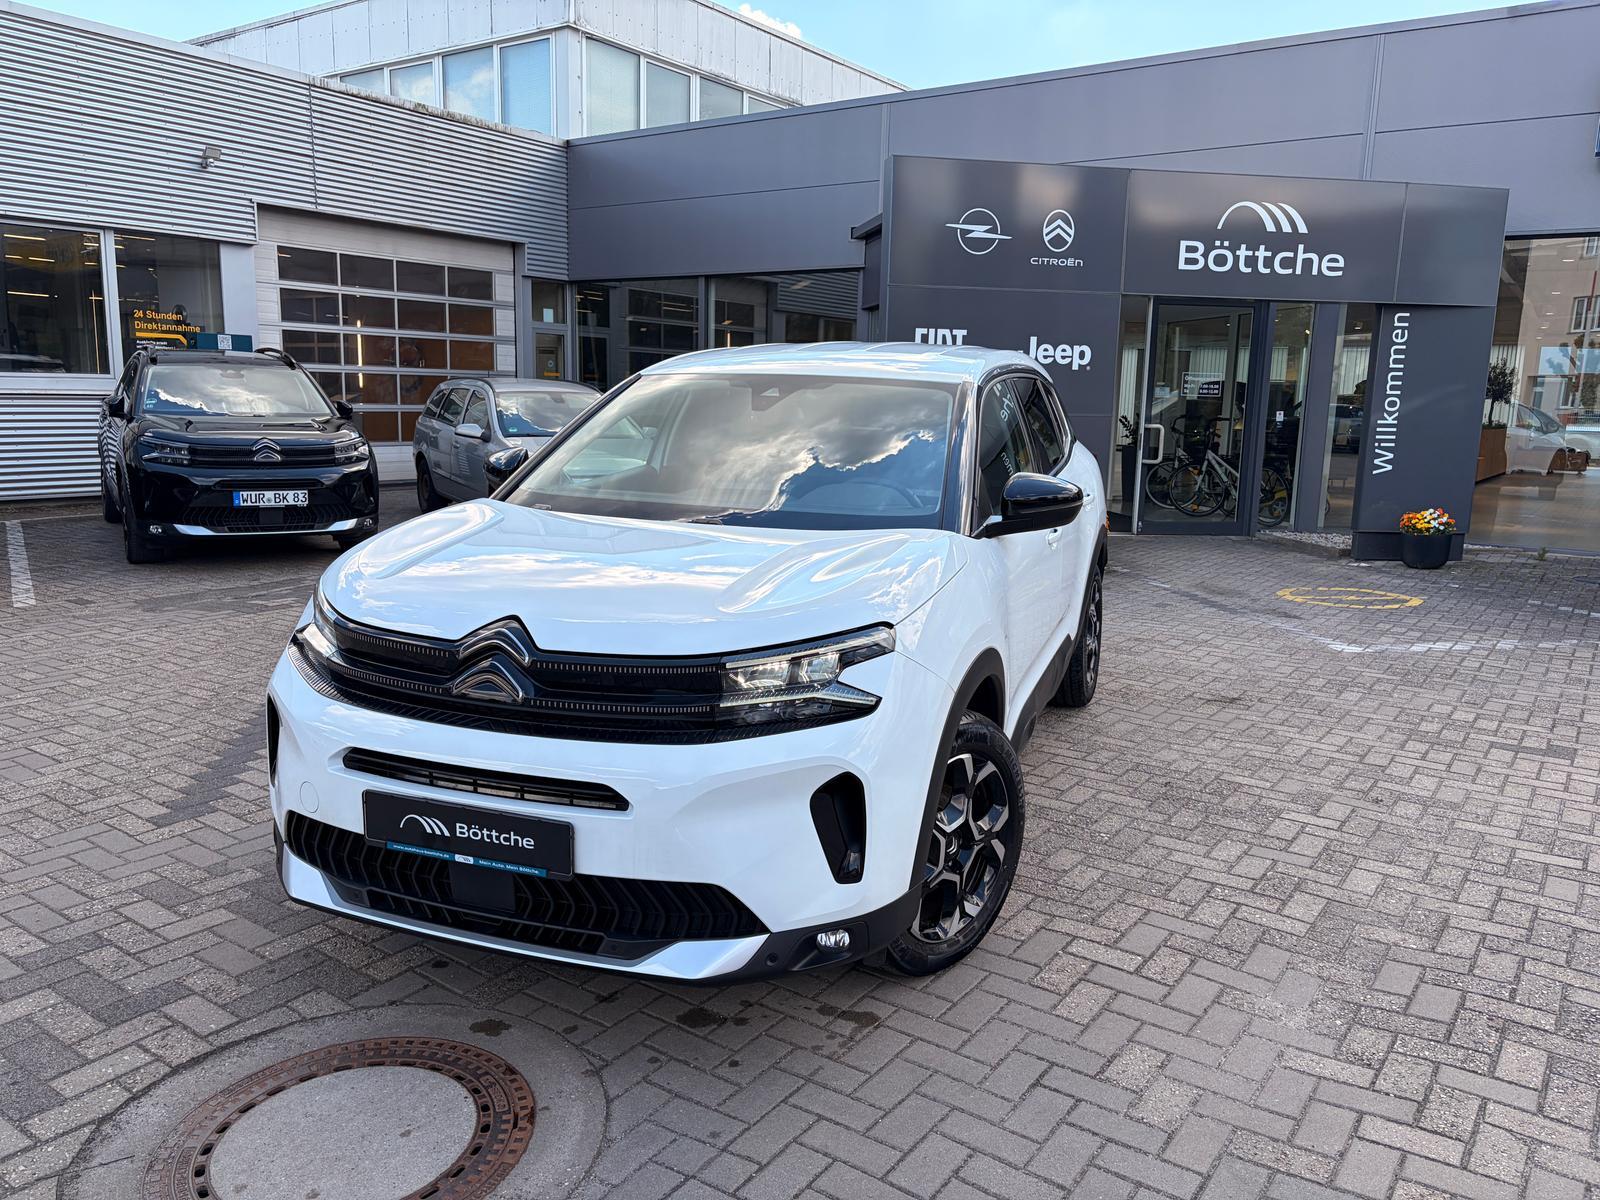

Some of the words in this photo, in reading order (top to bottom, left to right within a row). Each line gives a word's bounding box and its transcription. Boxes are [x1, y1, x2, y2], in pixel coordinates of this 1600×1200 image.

[1030, 257, 1084, 267] CITROËN
[1178, 240, 1345, 277] Böttche
[133, 309, 144, 318] 24
[146, 310, 183, 320] Stunden
[135, 321, 201, 333] Direktannahme
[1028, 336, 1092, 371] Jeep
[1372, 312, 1410, 474] Willkommen
[241, 492, 266, 504] WUR
[273, 492, 289, 504] BK
[292, 492, 308, 503] 83
[455, 823, 535, 849] Böttche
